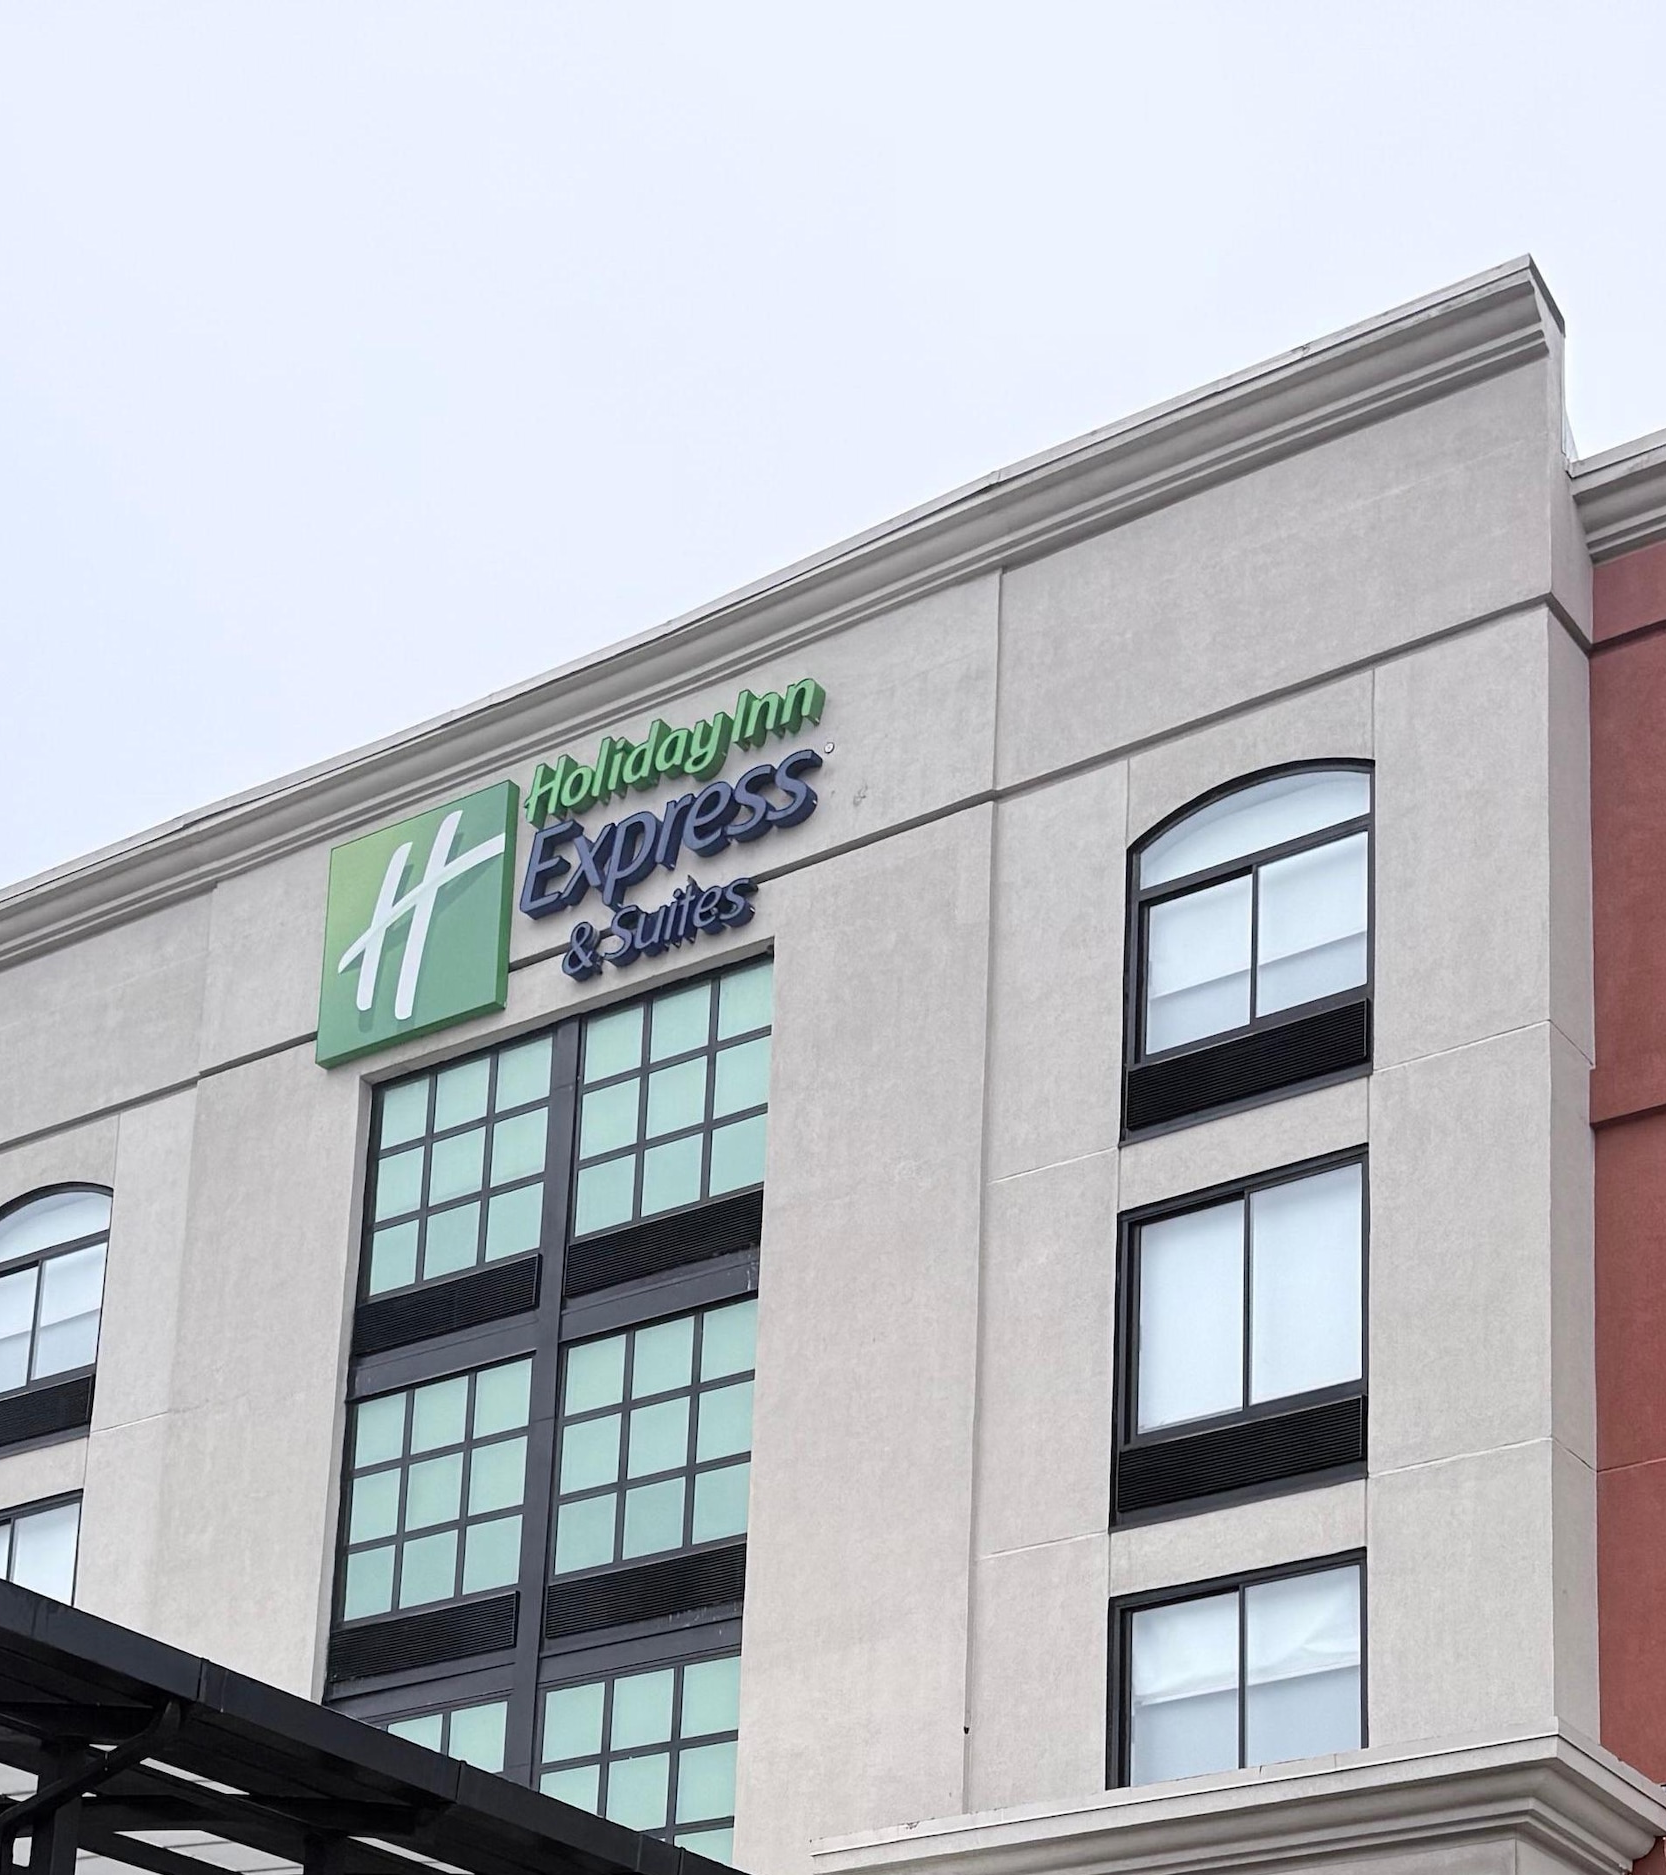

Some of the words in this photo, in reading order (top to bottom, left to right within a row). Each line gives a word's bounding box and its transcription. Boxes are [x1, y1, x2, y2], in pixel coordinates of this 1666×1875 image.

[524, 711, 732, 827] Holiday
[732, 677, 827, 752] Inn
[338, 810, 505, 1021] H
[519, 749, 823, 921] Express
[561, 922, 603, 982] &
[603, 875, 759, 968] Suites
